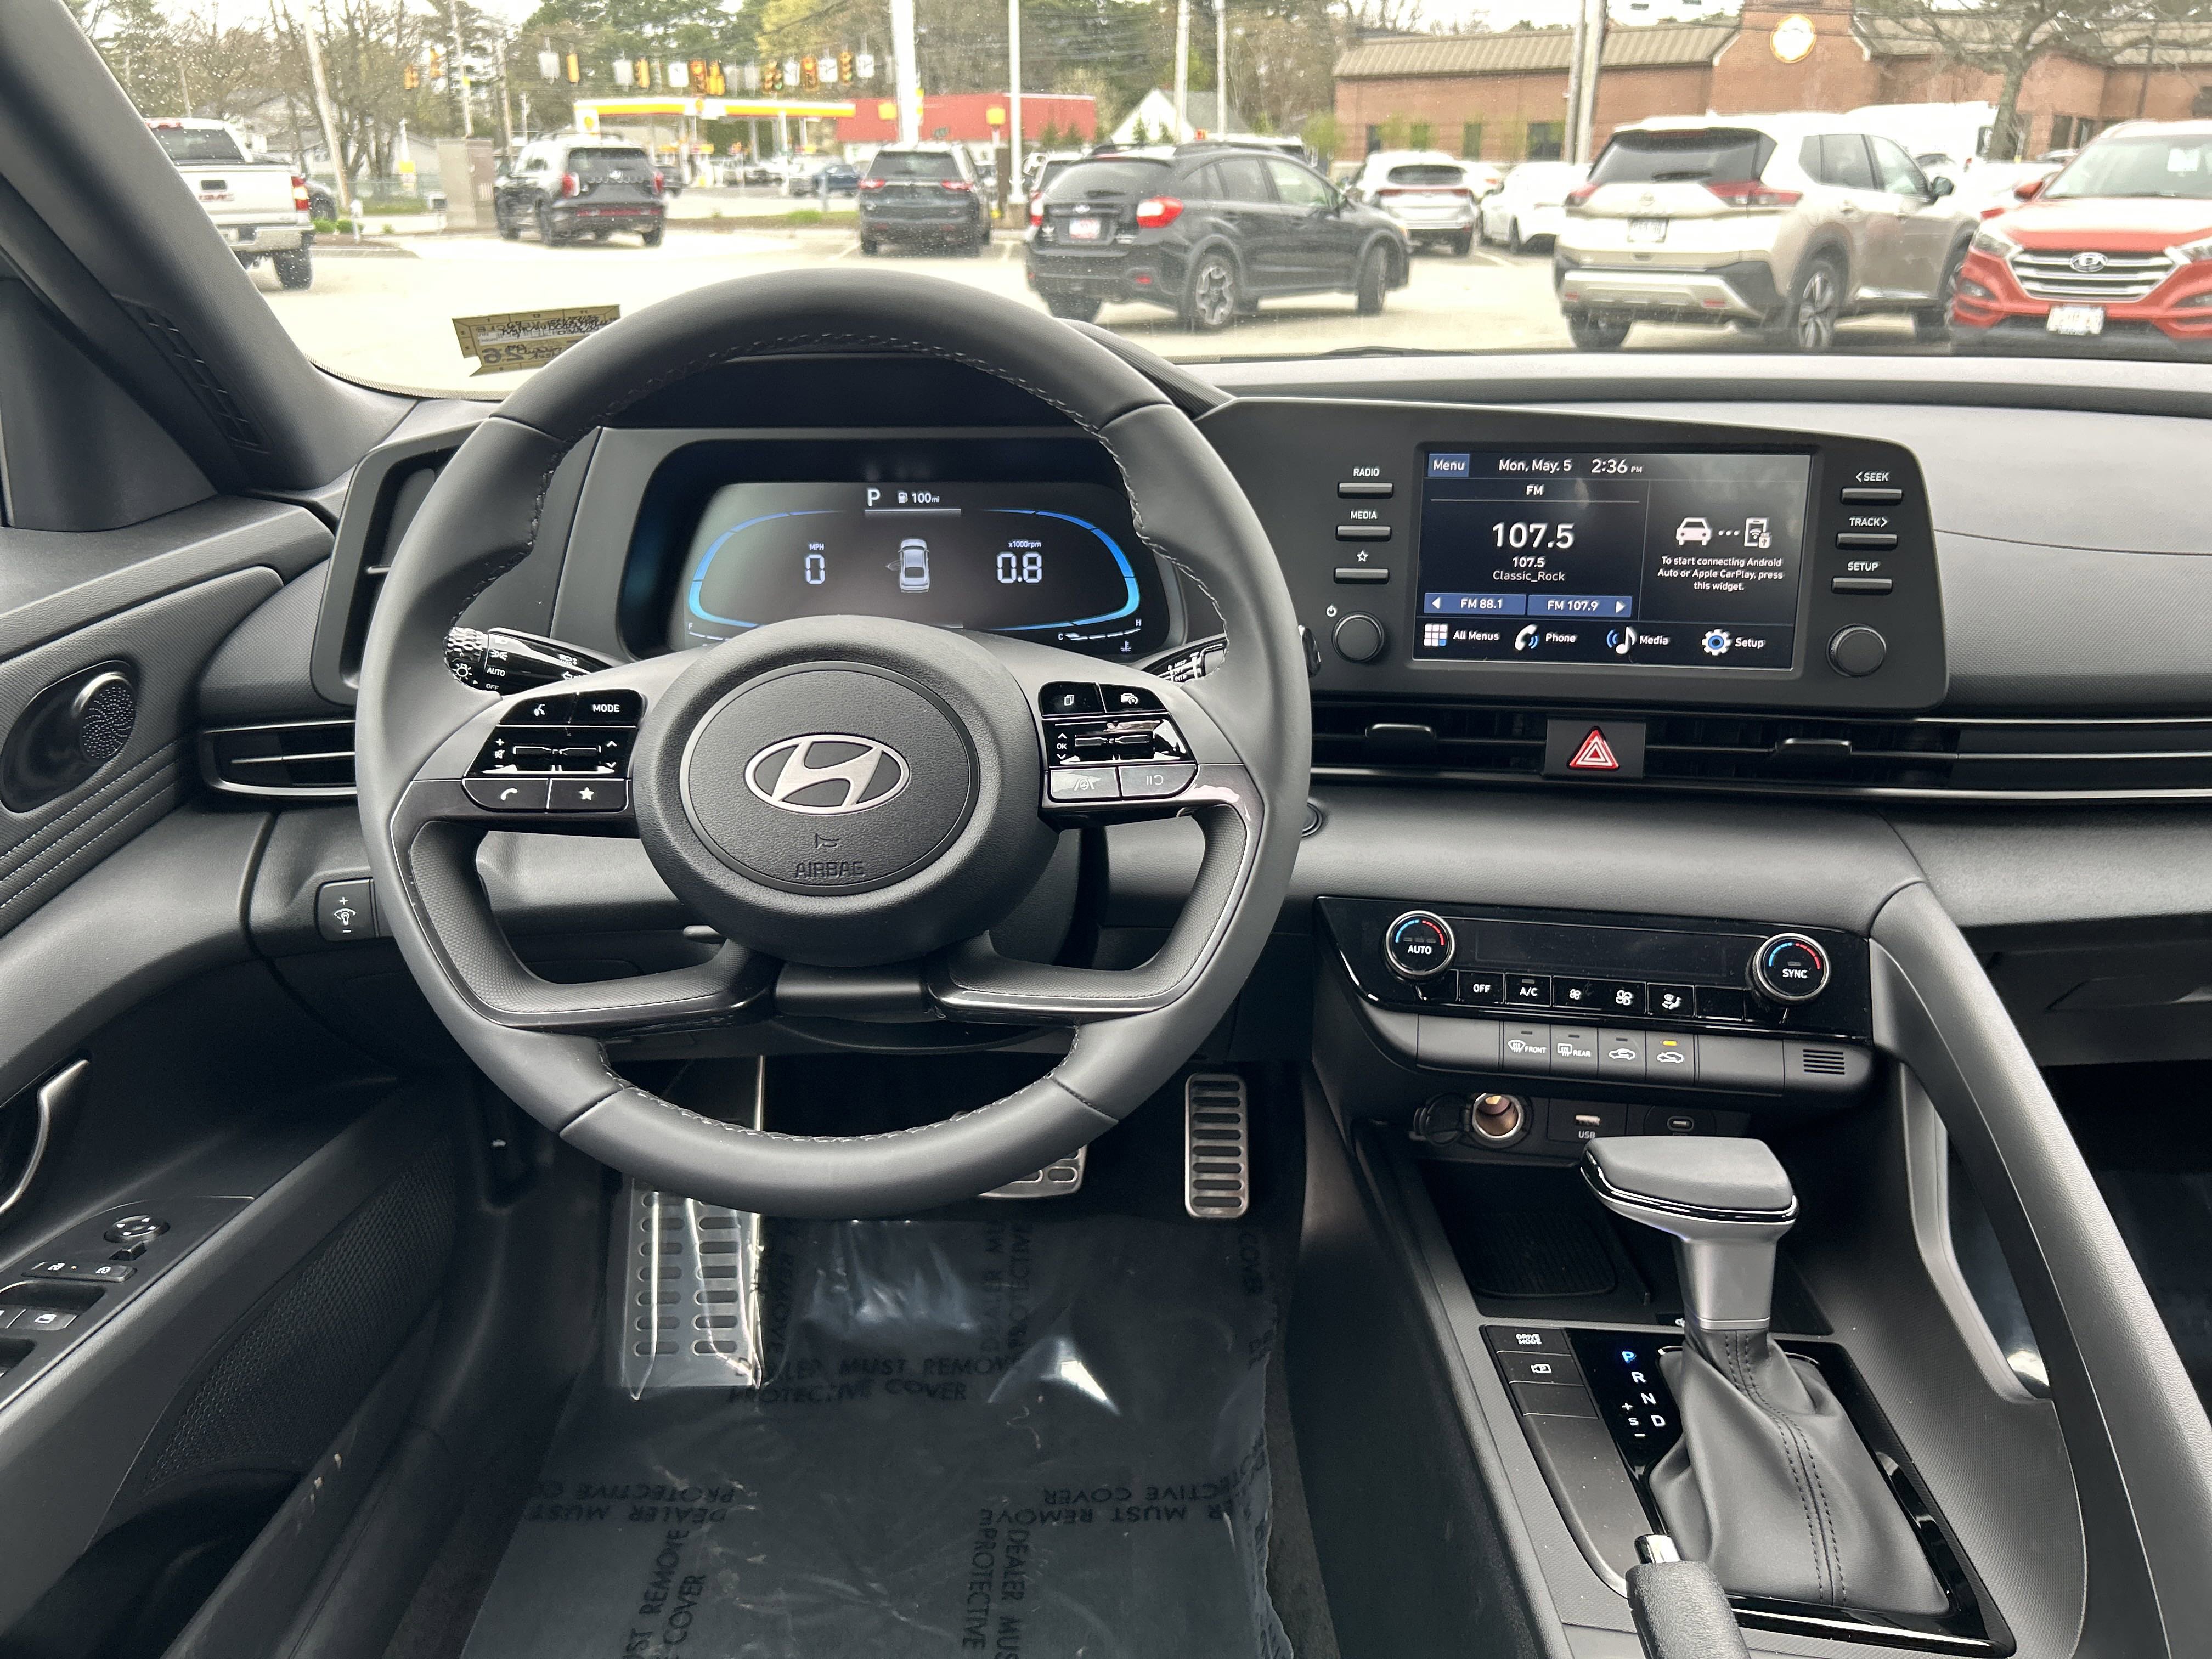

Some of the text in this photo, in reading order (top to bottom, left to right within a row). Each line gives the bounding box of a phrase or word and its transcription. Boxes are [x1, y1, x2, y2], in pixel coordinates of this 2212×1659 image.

[1432, 460, 1465, 471] Menu
[1499, 459, 1572, 473] Mon, May. 5
[1592, 459, 1628, 474] 2:36
[1353, 468, 1379, 477] RADIO
[1526, 486, 1543, 495] FM
[867, 488, 881, 507] P
[1350, 511, 1377, 520] MEDIA
[1493, 522, 1575, 549] 107.5
[1008, 540, 1041, 549] x1000rpm
[1512, 557, 1544, 568] 107.5
[1662, 556, 1782, 568] To start connecting Android
[1847, 562, 1878, 572] SETUP
[805, 554, 825, 585] 0
[996, 552, 1042, 584] 0.8
[1493, 571, 1565, 582] Classic_Rock
[1658, 568, 1678, 578] Auto
[1692, 569, 1718, 580] Apple
[1720, 570, 1756, 580] CarPlay,
[1758, 572, 1783, 582] press
[1694, 581, 1745, 592] this widget.
[1460, 599, 1502, 610] FM 88.1
[1547, 601, 1598, 611] FM 107.9
[1453, 630, 1499, 641] All Menus
[1546, 634, 1576, 643] Phone
[1640, 635, 1668, 645] Media
[1735, 637, 1764, 648] Setup
[487, 667, 505, 677] AUTO
[592, 704, 620, 713] MODE
[795, 861, 866, 879] AIRBAG
[1407, 945, 1432, 955] AUTO
[1782, 968, 1808, 979] SYNC
[1473, 984, 1491, 994] OFF
[1519, 987, 1538, 997] A/C
[1525, 1046, 1547, 1054] FRONT
[1573, 1049, 1591, 1057] REAR
[1578, 1130, 1596, 1139] USB
[1622, 1351, 1637, 1364] P
[839, 1357, 907, 1375] MUST
[1632, 1372, 1646, 1384] R
[884, 1378, 967, 1401] COVER
[1641, 1393, 1656, 1405] N
[1628, 1417, 1639, 1426] S
[1651, 1414, 1666, 1427] D
[1044, 1486, 1132, 1505] COVER
[980, 1508, 1093, 1525] REMOVE
[1110, 1505, 1187, 1523] MUST
[638, 1529, 690, 1615] REMOVE
[962, 1527, 998, 1650] PROTECTIVE
[994, 1528, 1031, 1659] DEALER MUS
[662, 1575, 706, 1646] COVER
